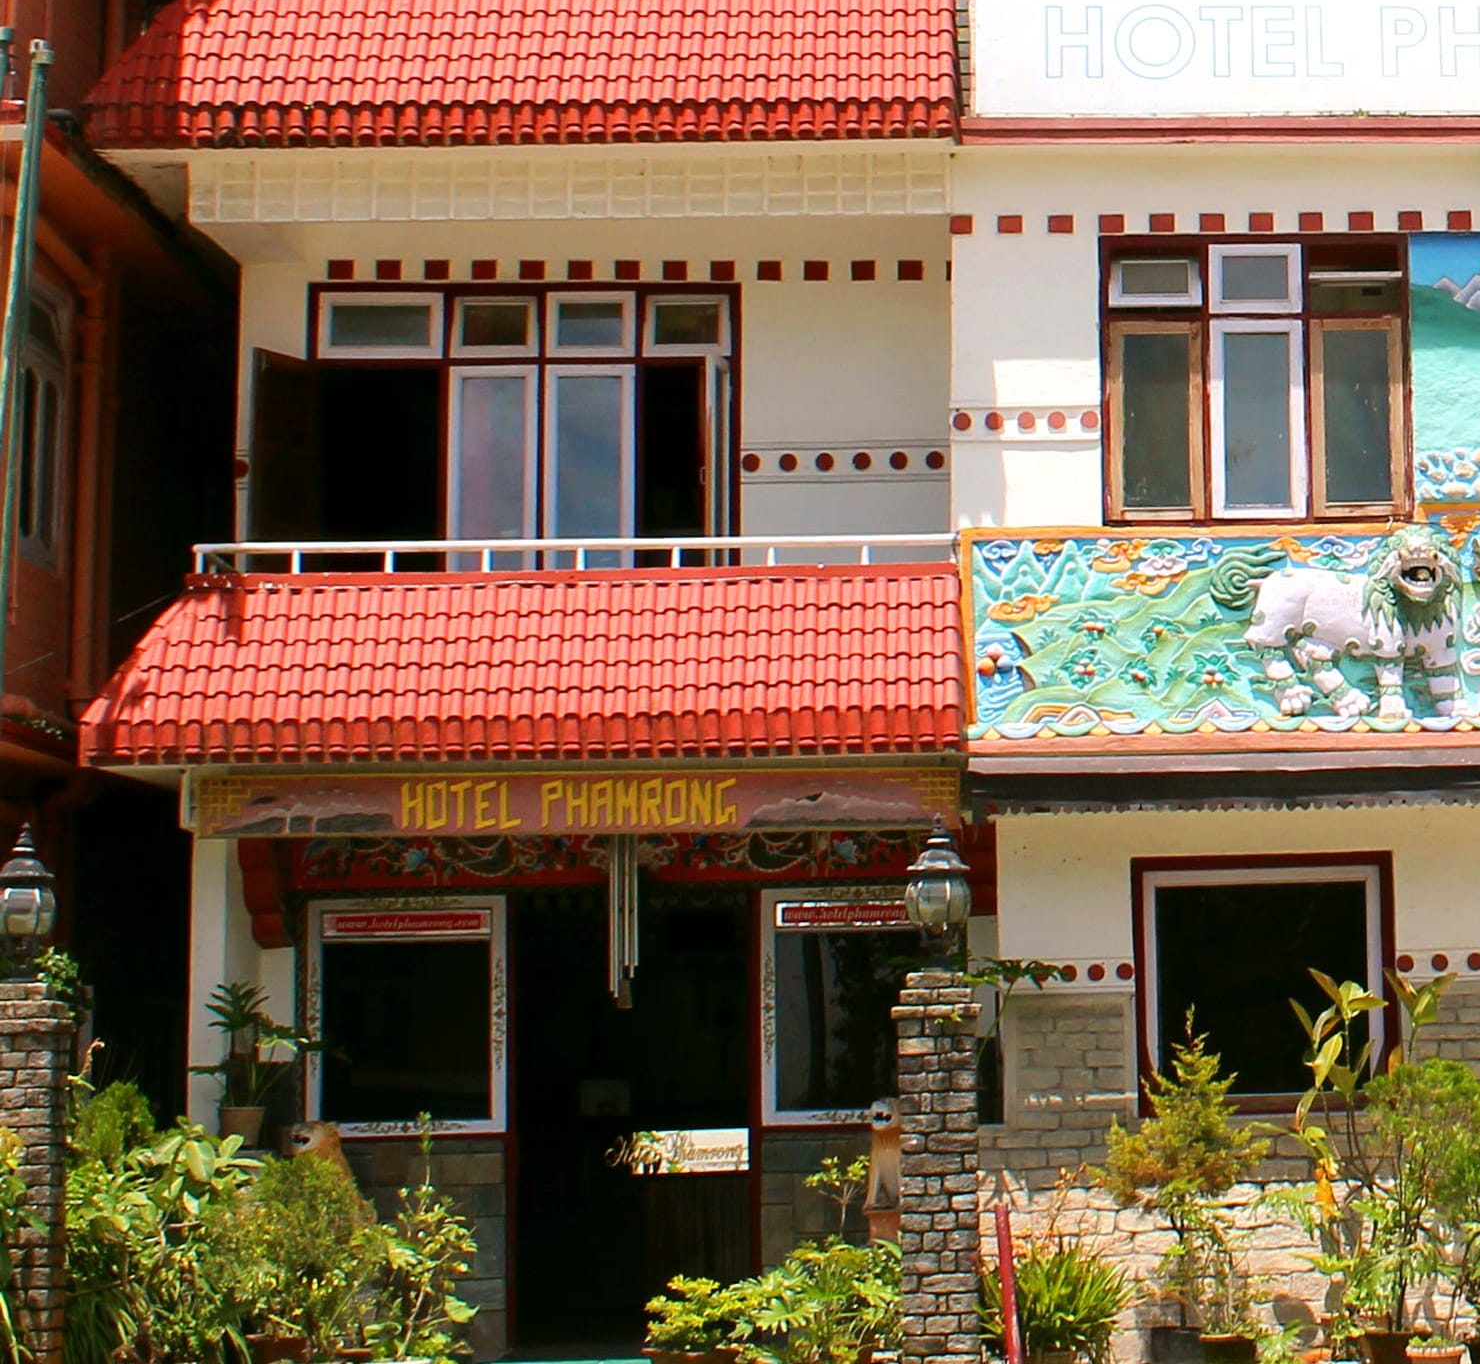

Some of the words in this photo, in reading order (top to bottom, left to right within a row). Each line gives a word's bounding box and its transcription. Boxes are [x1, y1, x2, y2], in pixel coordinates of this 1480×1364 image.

[1045, 3, 1344, 80] HOTEL
[400, 780, 522, 831] HOTEL
[541, 777, 737, 829] PHAMRONG
[784, 906, 908, 924] www.hotelphamrong
